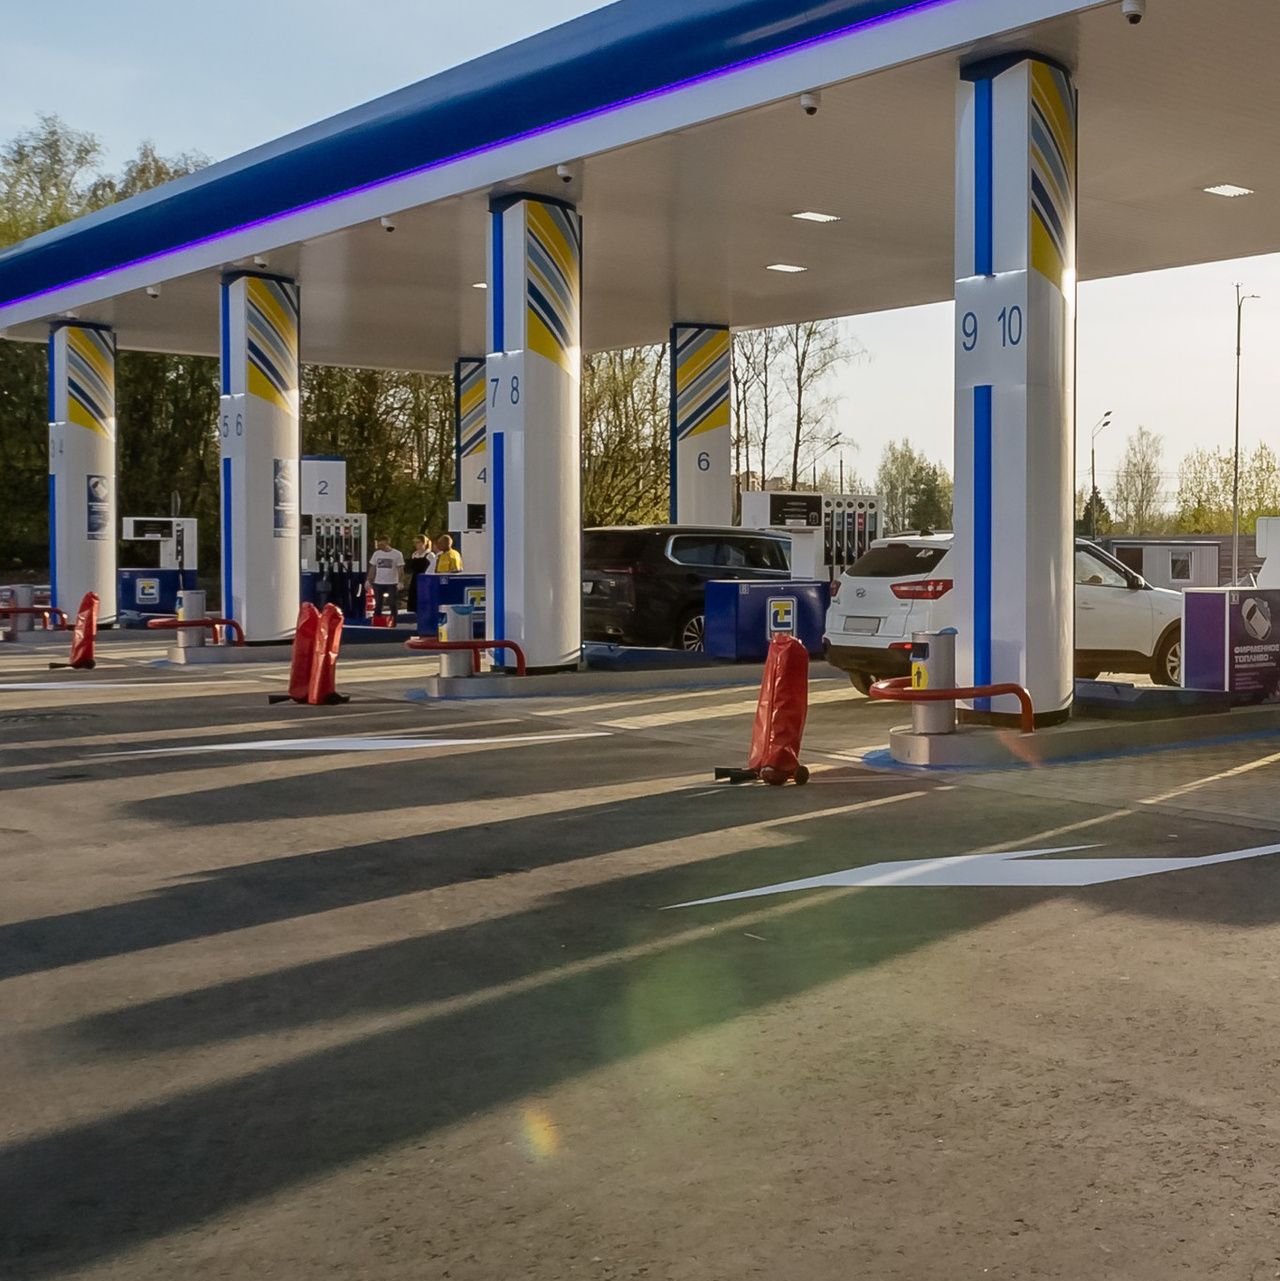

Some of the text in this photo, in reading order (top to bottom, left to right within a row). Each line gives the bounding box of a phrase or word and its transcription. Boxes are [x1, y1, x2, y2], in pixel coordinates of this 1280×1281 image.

[962, 305, 1022, 352] 9 10
[490, 375, 520, 408] 7 8
[222, 413, 243, 438] 5 6
[697, 451, 710, 472] 6
[476, 467, 487, 484] 4
[317, 480, 329, 495] 2
[1234, 644, 1280, 654] ФИРМЕННОЕ
[1234, 654, 1269, 663] ТОПЛИВО
